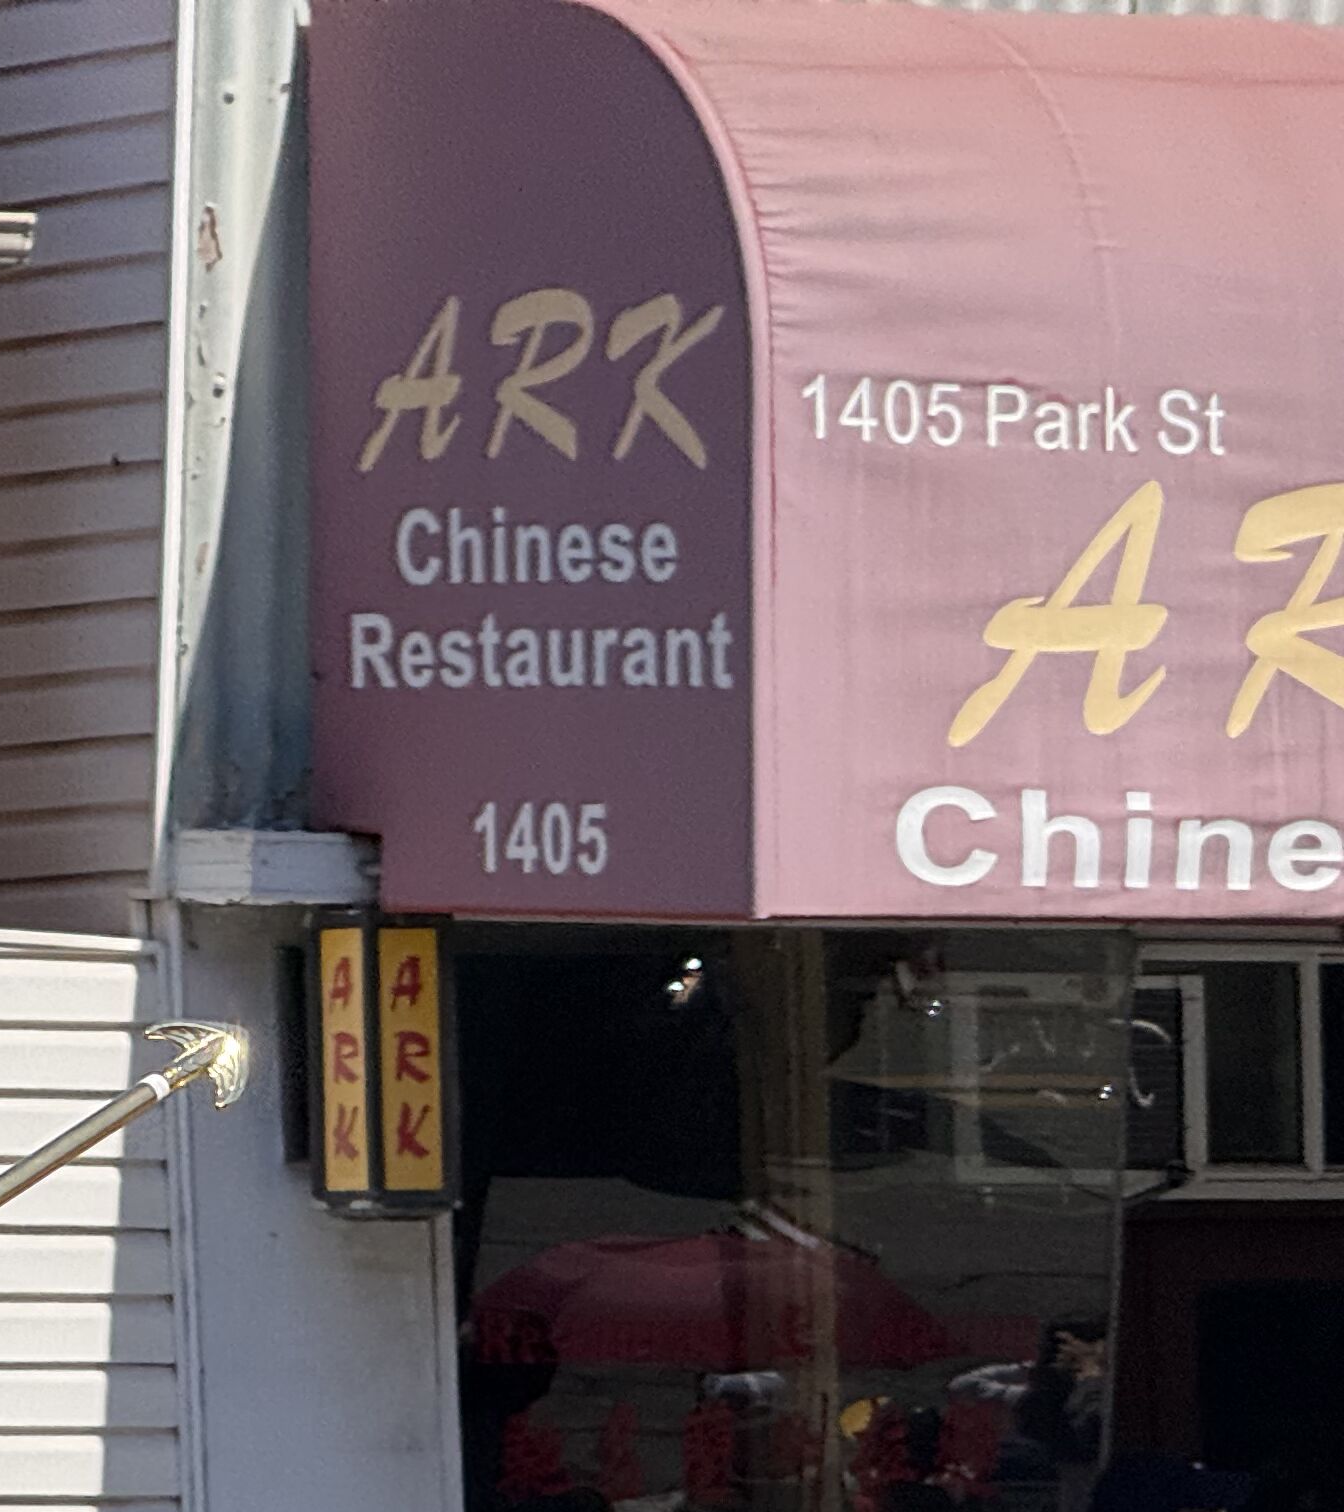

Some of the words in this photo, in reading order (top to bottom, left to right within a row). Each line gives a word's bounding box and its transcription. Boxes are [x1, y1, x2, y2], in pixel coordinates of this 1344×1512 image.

[358, 286, 724, 472] ARK
[800, 372, 965, 448] 1405
[986, 385, 1137, 454] Park
[1156, 390, 1226, 457] St
[395, 504, 678, 585] Chinese
[350, 611, 734, 691] Restaurant
[473, 801, 609, 876] 1405
[894, 783, 1344, 894] Chine
[327, 955, 361, 1163] ARK
[390, 953, 432, 1160] ARK
